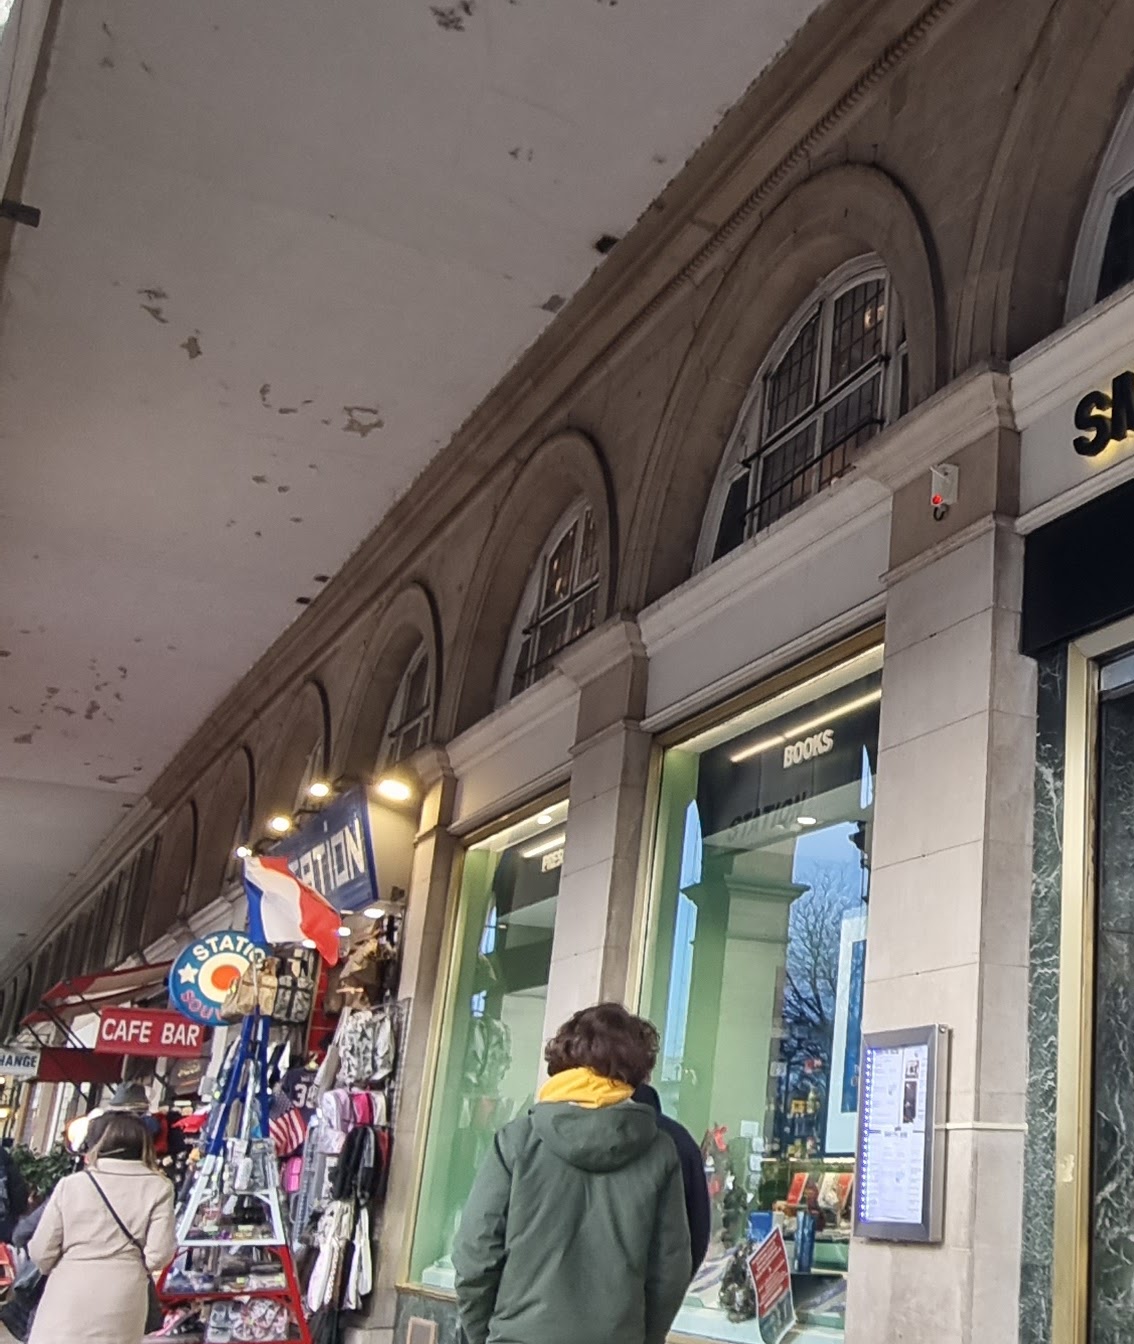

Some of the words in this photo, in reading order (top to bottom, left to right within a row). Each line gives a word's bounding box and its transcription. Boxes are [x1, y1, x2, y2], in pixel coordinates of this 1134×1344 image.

[783, 729, 835, 769] BOOKS
[192, 934, 266, 968] STATIO
[102, 1018, 153, 1043] CAFE
[161, 1022, 201, 1047] BAR
